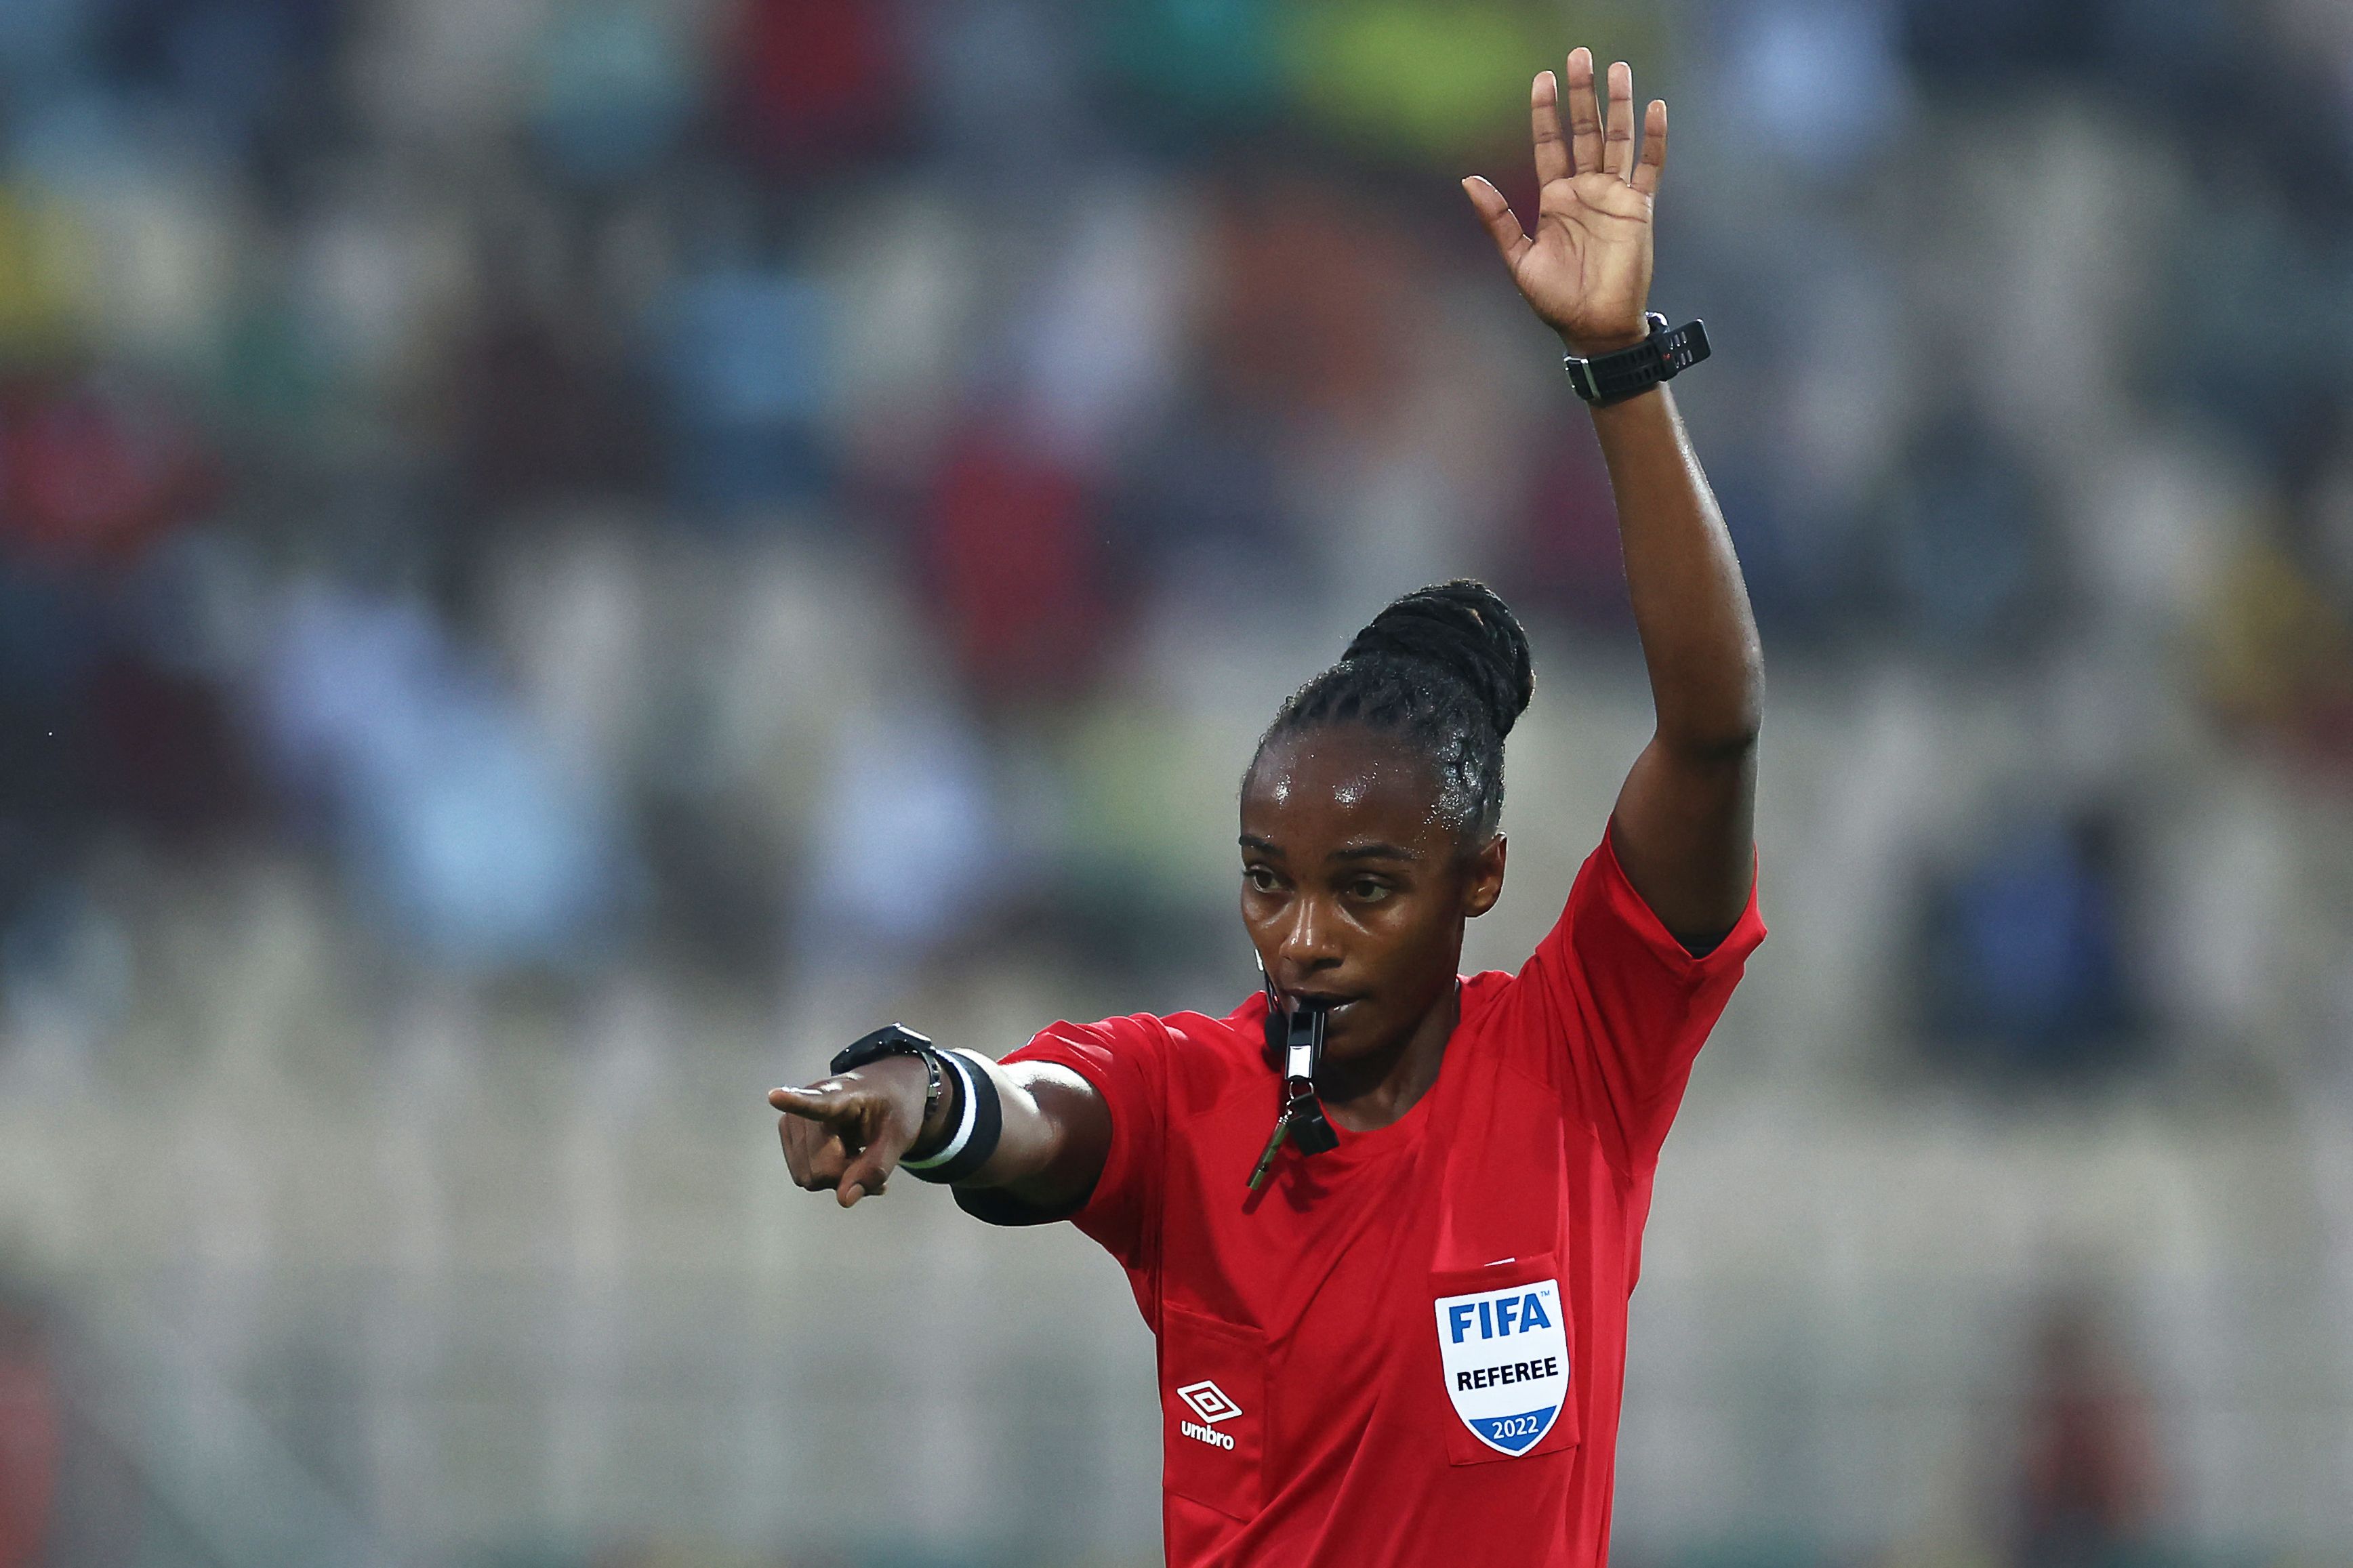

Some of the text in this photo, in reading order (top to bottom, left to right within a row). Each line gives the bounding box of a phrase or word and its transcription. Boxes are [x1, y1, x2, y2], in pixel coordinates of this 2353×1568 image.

[1449, 1293, 1551, 1344] FIFA
[1457, 1357, 1558, 1391] REFEREE
[1181, 1420, 1234, 1449] umbro
[1492, 1416, 1539, 1439] 2022
